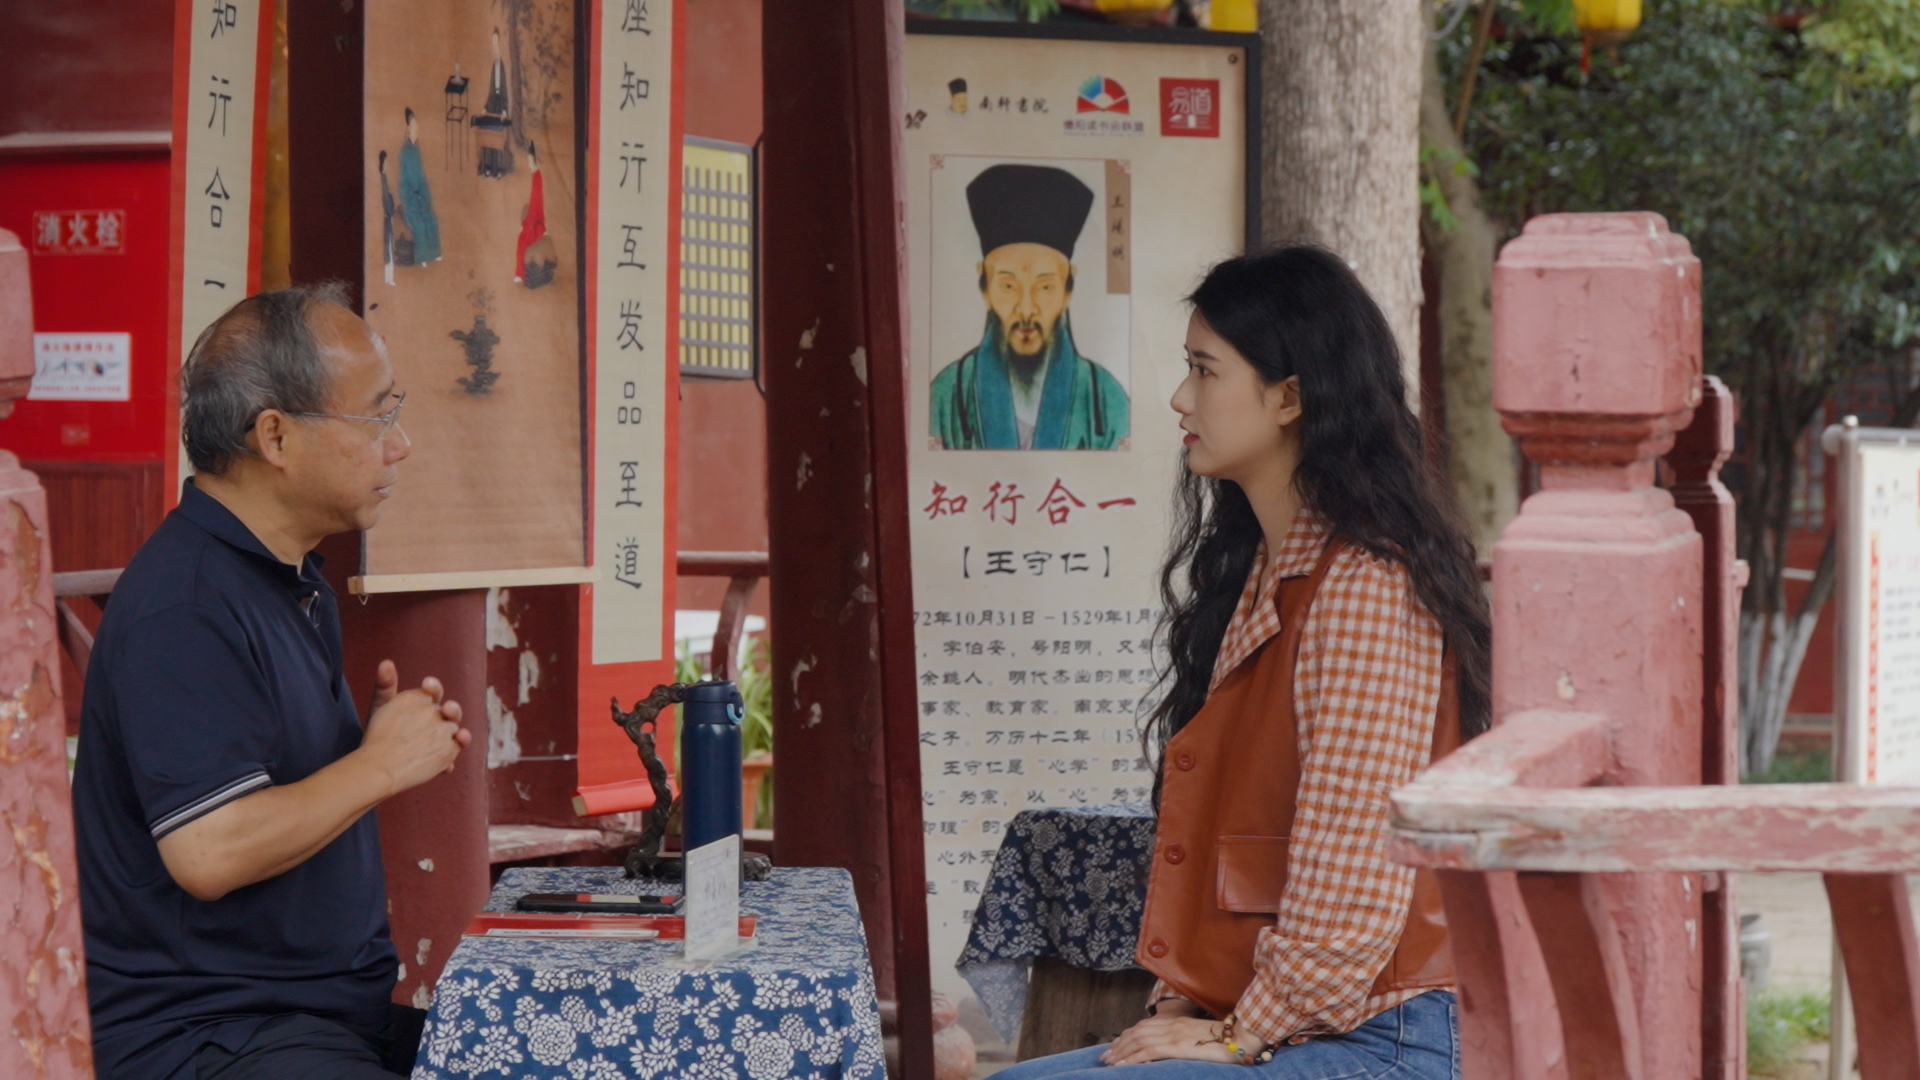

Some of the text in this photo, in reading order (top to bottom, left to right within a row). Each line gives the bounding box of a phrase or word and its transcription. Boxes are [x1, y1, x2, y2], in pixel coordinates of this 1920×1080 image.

[37, 213, 119, 246] 消火栓
[923, 477, 1137, 525] 知行合一
